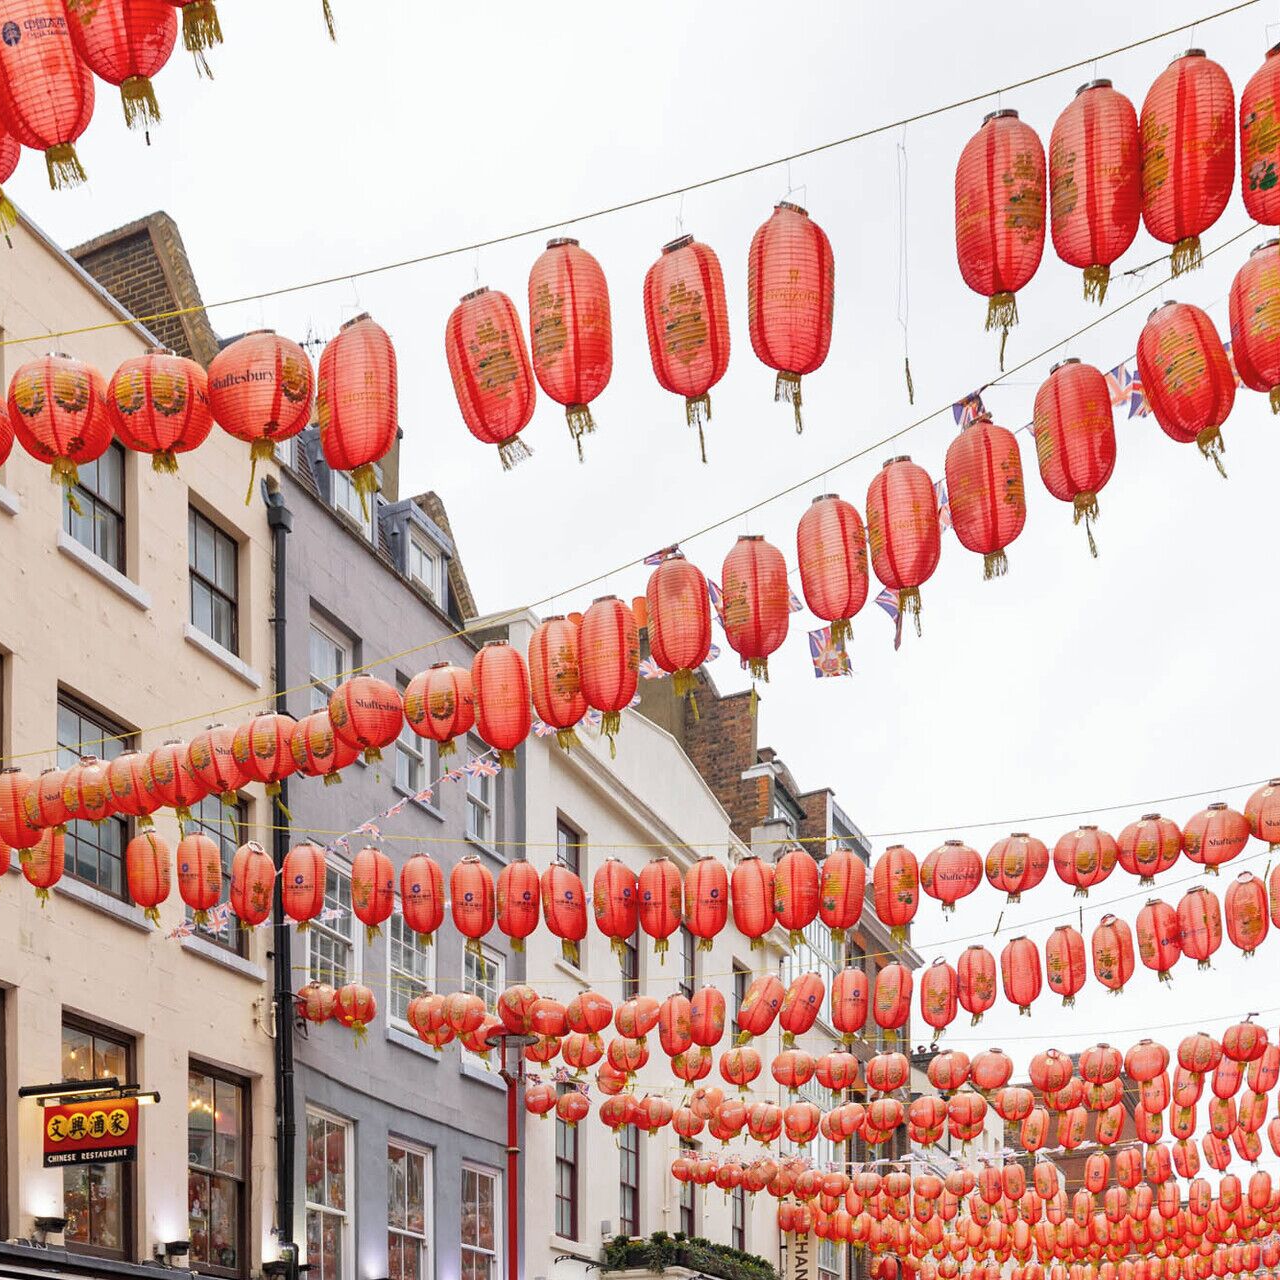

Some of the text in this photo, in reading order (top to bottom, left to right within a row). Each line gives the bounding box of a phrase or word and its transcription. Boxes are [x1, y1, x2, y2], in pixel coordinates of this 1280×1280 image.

[50, 1112, 126, 1138] 文興酒家
[48, 1149, 128, 1163] CHINESE RESTAURANT
